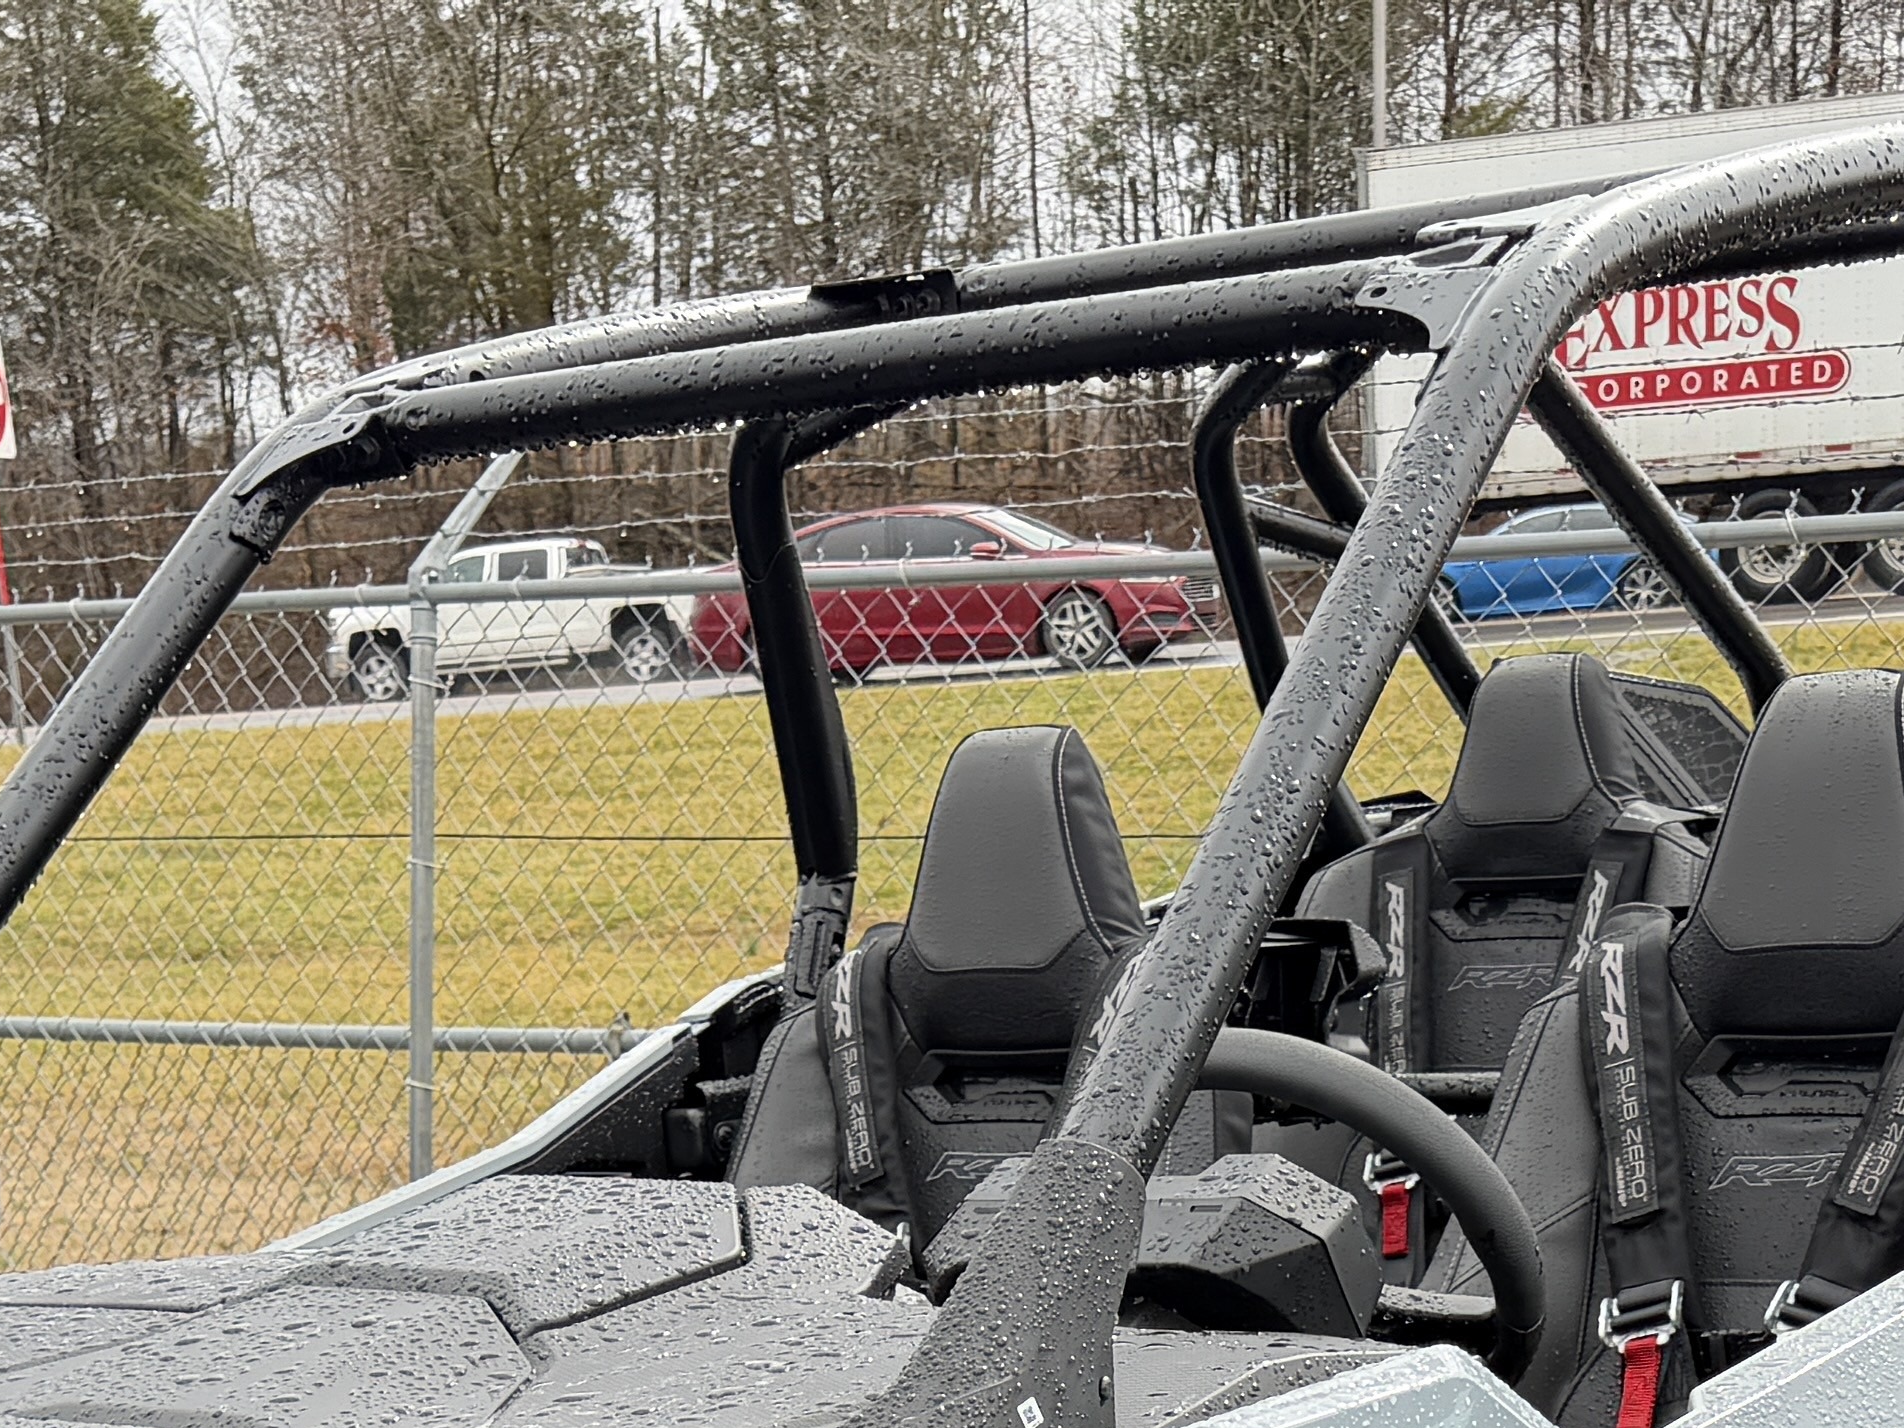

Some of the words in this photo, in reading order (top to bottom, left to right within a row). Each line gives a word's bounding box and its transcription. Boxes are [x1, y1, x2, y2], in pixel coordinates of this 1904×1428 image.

[1385, 881, 1405, 978] RZR
[1600, 942, 1629, 1056] RZR
[1619, 1065, 1639, 1121] SUB
[1624, 1126, 1648, 1200] ZERO
